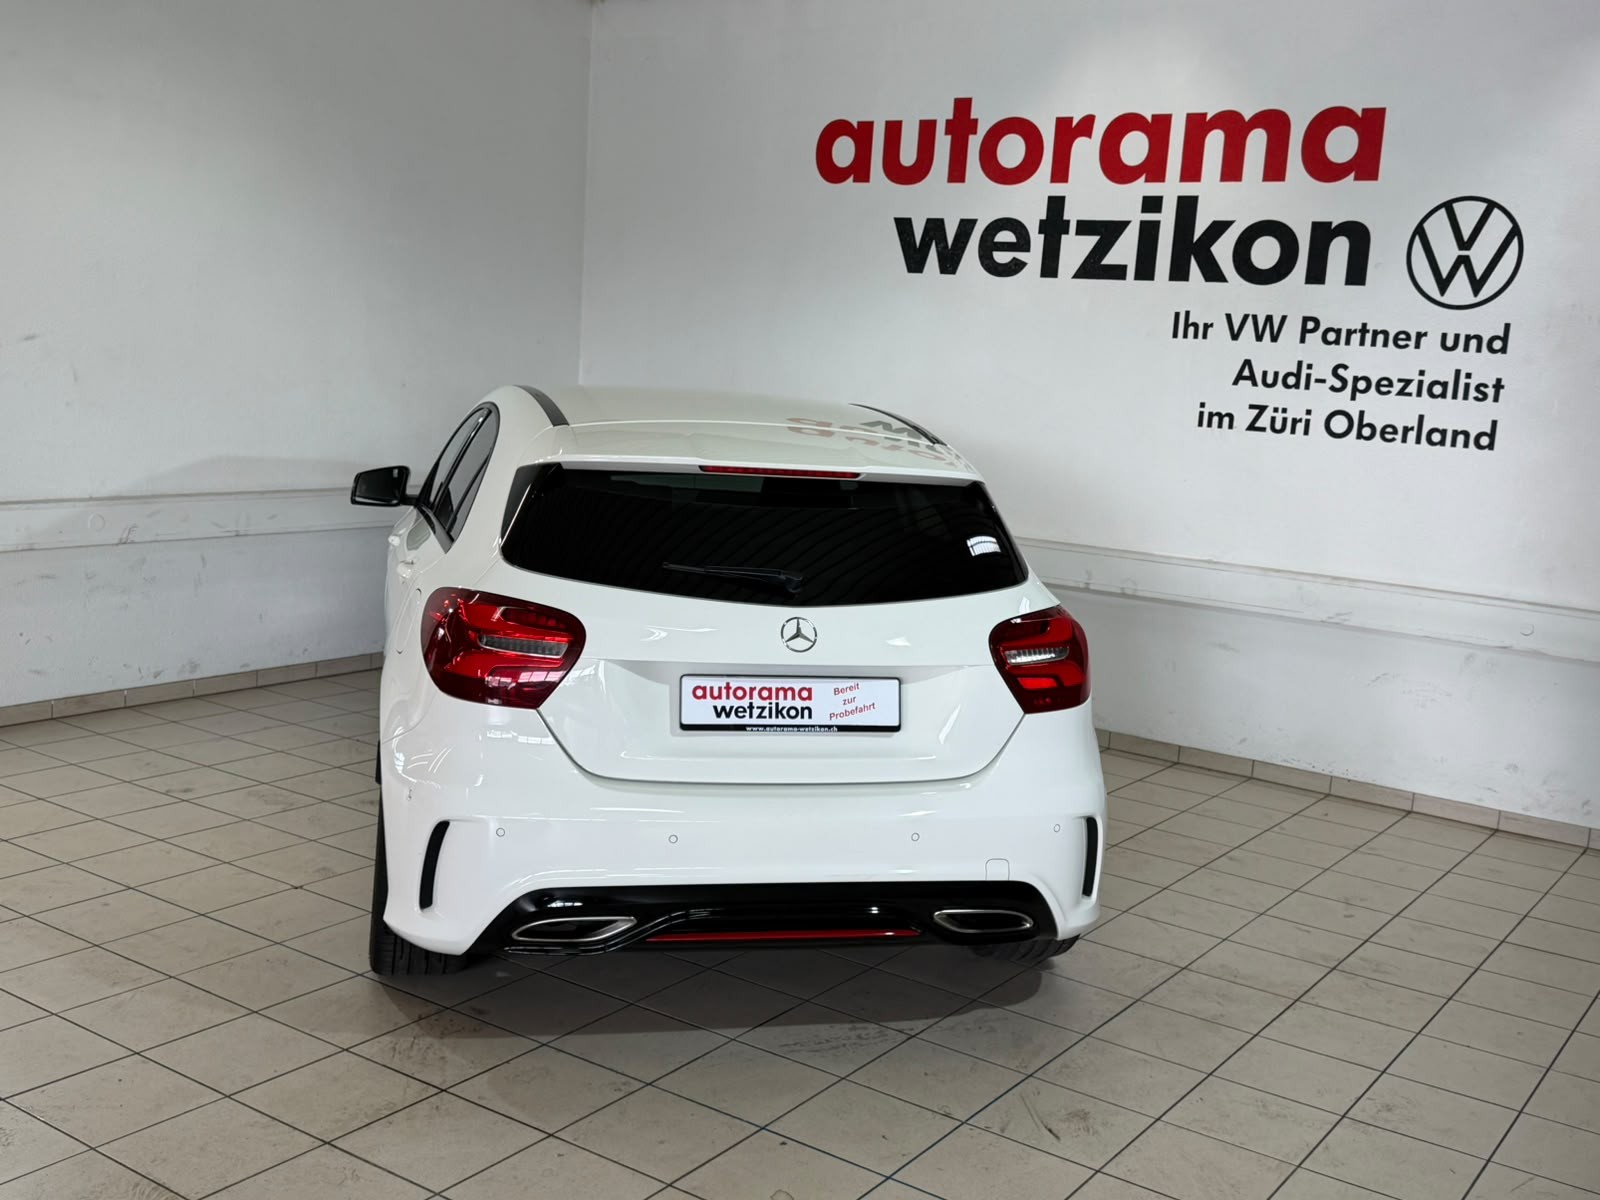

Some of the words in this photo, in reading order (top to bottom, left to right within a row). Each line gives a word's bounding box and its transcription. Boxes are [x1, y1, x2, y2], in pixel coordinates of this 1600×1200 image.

[816, 98, 1386, 185] autorama
[894, 196, 1370, 286] wetzikon
[1173, 311, 1214, 340] Ihr
[1225, 313, 1288, 343] VW
[1300, 316, 1428, 350] Partner
[1441, 323, 1511, 355] und
[1232, 359, 1505, 402] Audi-Spezialist
[1198, 402, 1235, 430] im
[1246, 404, 1312, 436] Züri
[1325, 410, 1498, 451] Oberland
[691, 682, 813, 702] autorama
[833, 682, 860, 696] Bereit
[842, 696, 857, 706] zur
[713, 702, 813, 720] wetzikon
[829, 701, 876, 720] Probefahrt
